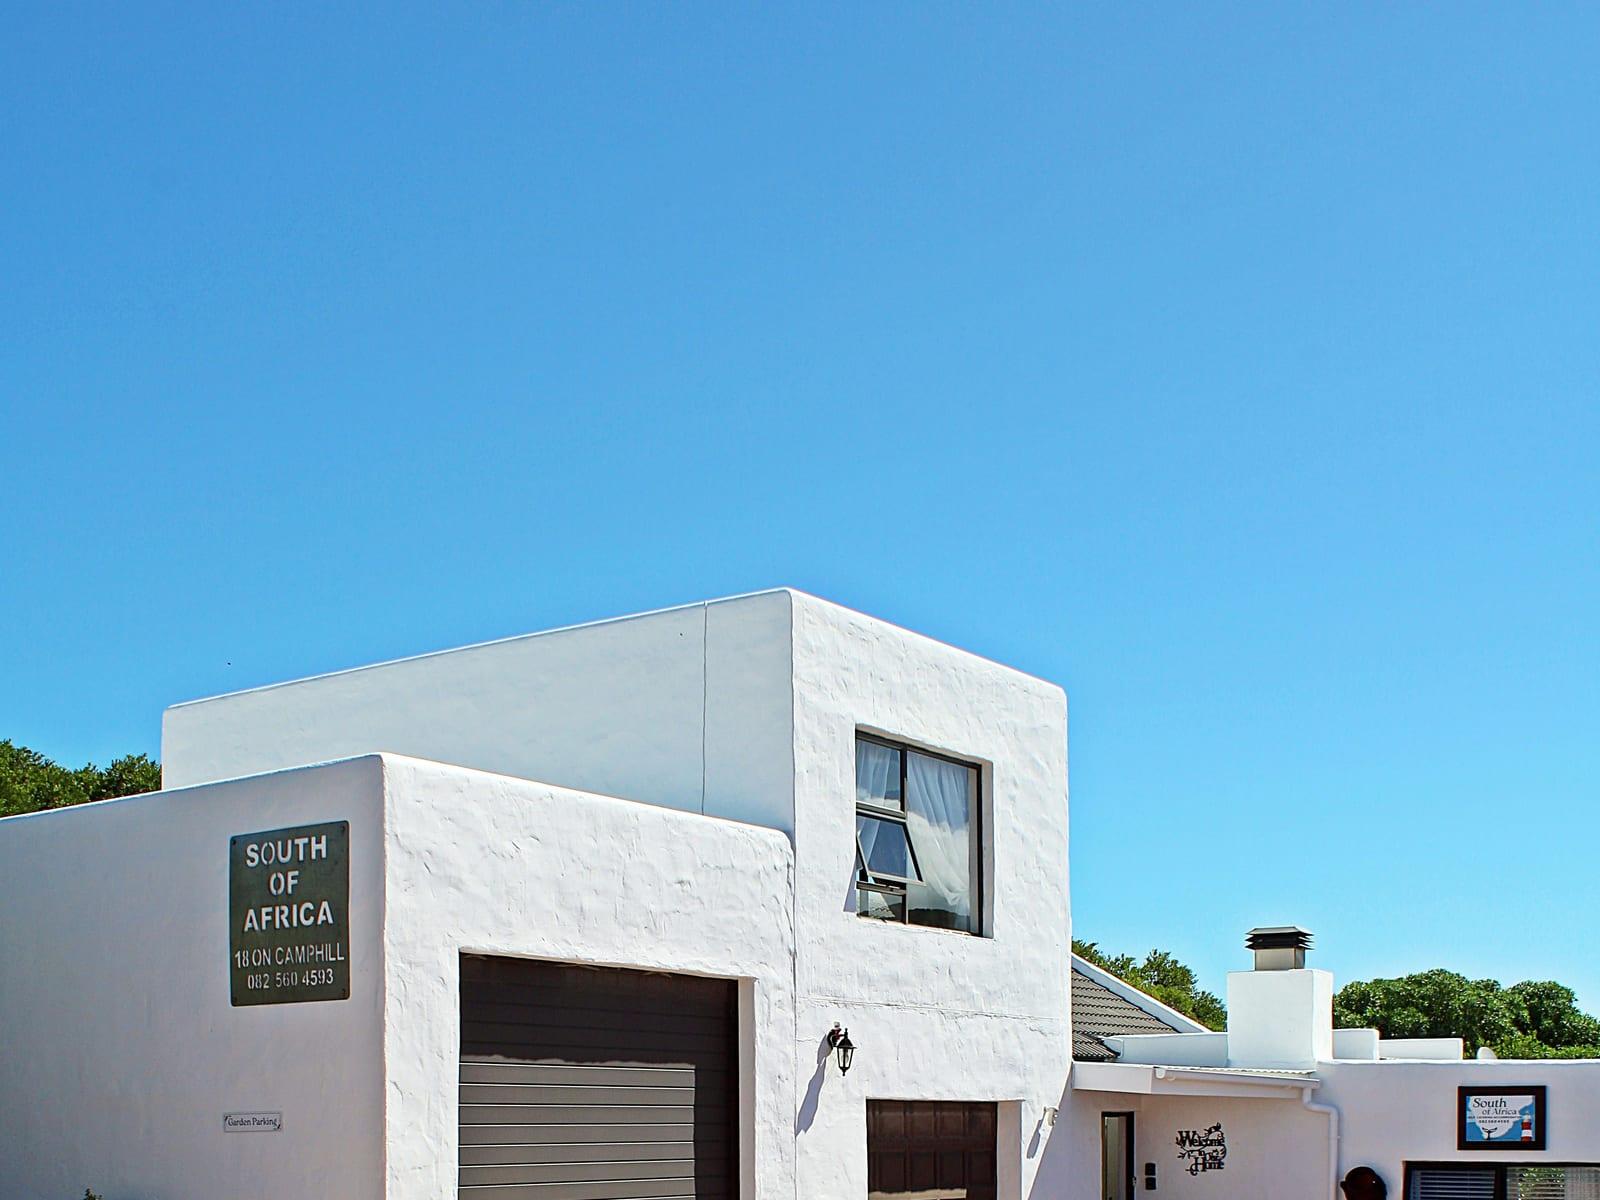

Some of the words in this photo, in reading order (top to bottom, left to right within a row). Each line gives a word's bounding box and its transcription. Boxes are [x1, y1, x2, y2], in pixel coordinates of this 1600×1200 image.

[246, 834, 327, 868] SOUTH
[269, 870, 299, 896] OF
[243, 901, 334, 932] AFRICA
[235, 950, 249, 968] 18
[251, 948, 271, 967] ON
[275, 943, 345, 966] CAMPHILL
[247, 973, 270, 989] 082
[275, 971, 298, 988] 560
[301, 968, 334, 986] 4593
[1472, 1097, 1507, 1108] South
[1492, 1108, 1517, 1116] Africa
[227, 1117, 252, 1127] Garden
[252, 1117, 277, 1127] Parking
